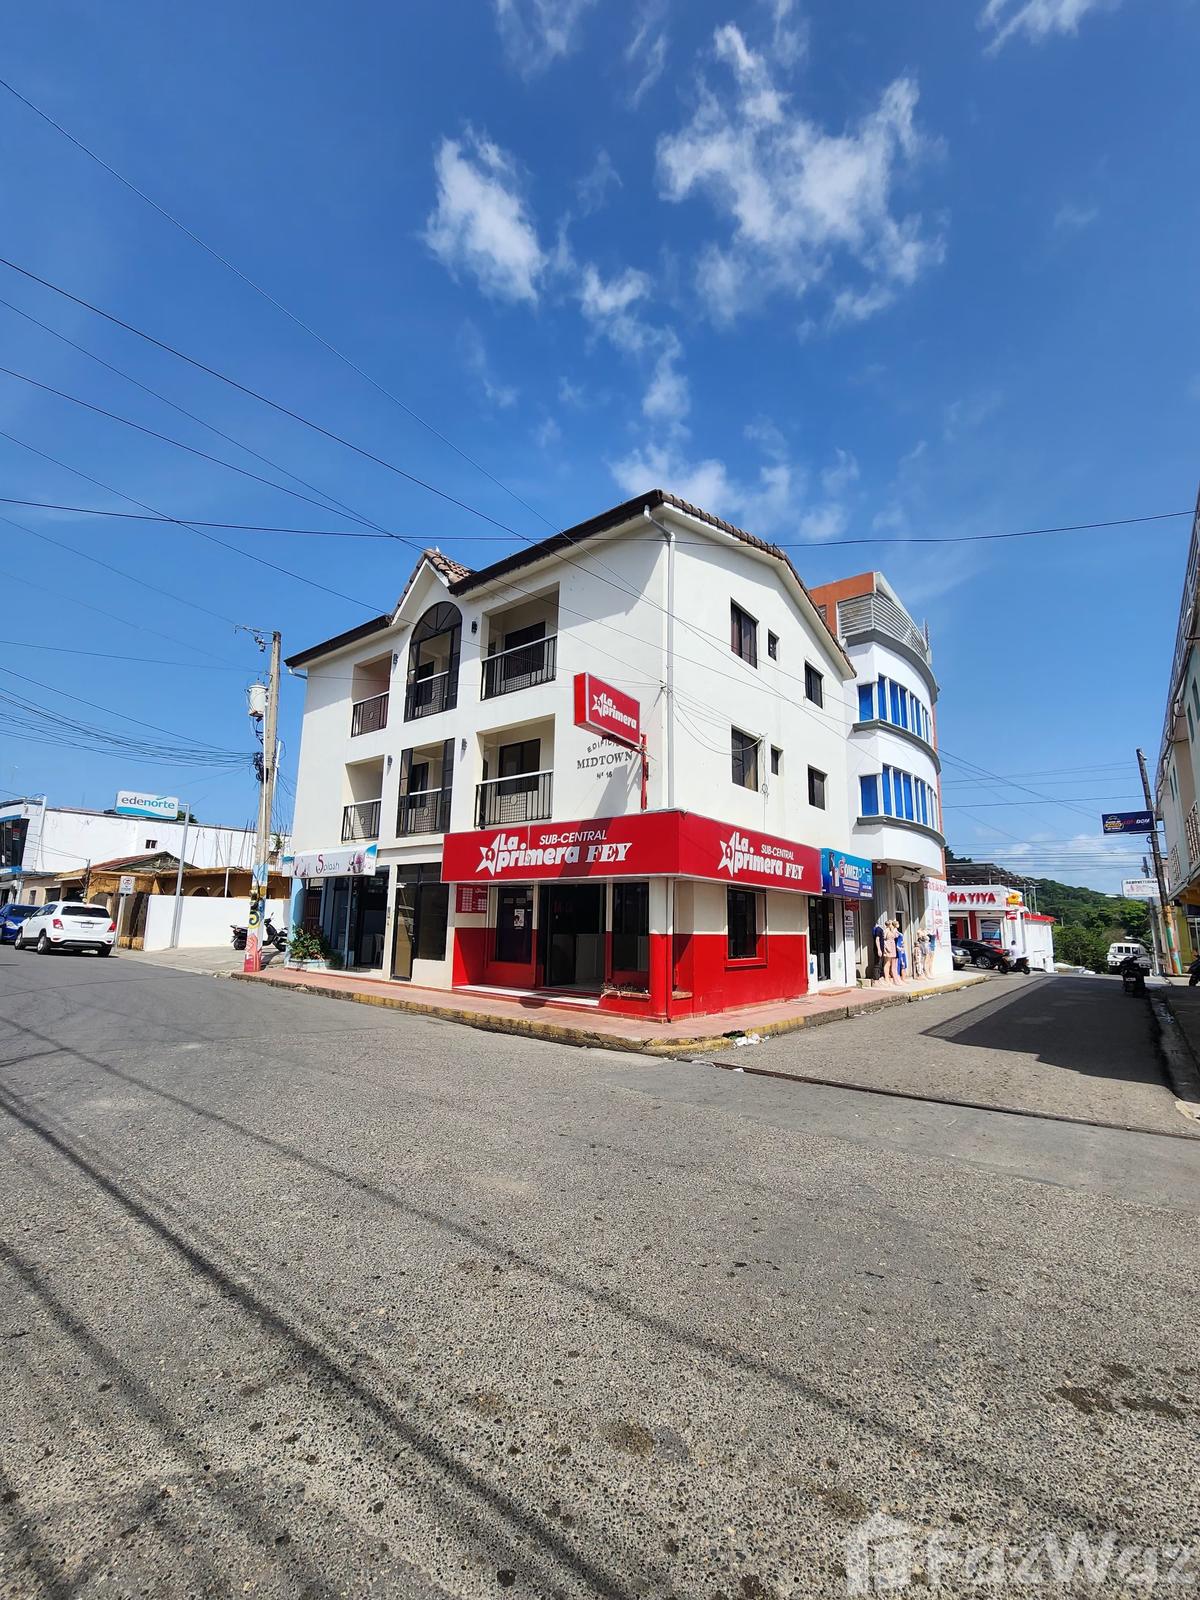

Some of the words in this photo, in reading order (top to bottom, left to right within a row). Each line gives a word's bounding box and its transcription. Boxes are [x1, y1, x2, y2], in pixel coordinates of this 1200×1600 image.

[603, 692, 612, 707] La
[602, 703, 637, 730] primera
[576, 751, 633, 770] MIDTOWN
[121, 796, 175, 810] edenorte
[499, 833, 519, 851] La
[539, 829, 607, 846] SUB-CENTRAL
[734, 832, 750, 852] La
[496, 843, 580, 872] primera
[585, 843, 633, 863] FEY
[760, 844, 795, 861] SUB-CENTRAL
[733, 847, 784, 875] primera
[784, 862, 805, 880] FEY
[947, 892, 966, 904] ÑA
[968, 892, 996, 904] YIYA
